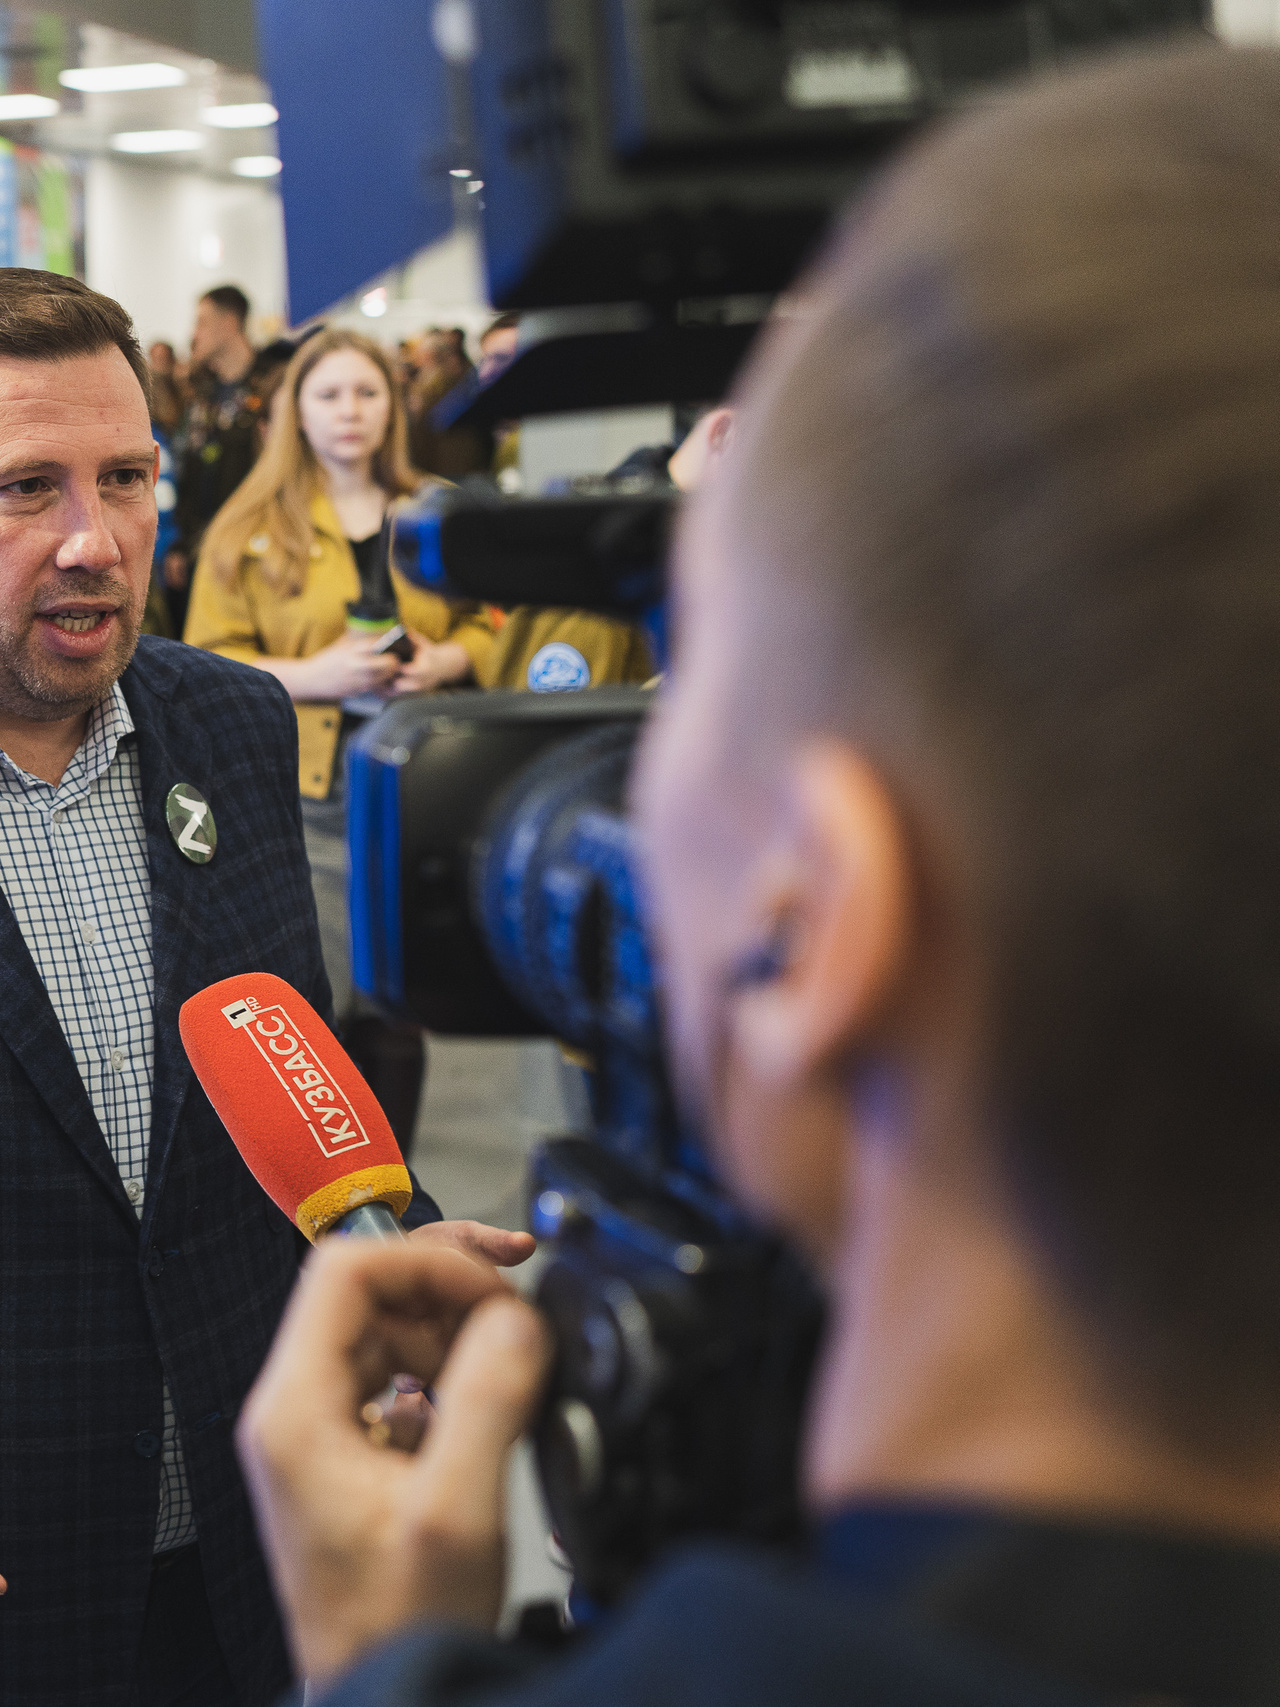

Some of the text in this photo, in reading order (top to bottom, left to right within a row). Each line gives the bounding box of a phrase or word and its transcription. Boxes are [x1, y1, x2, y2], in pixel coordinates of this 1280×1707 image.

[174, 794, 212, 855] Z
[229, 1008, 247, 1020] 1
[245, 996, 262, 1011] HD
[256, 1015, 357, 1144] КУЗБАСС
